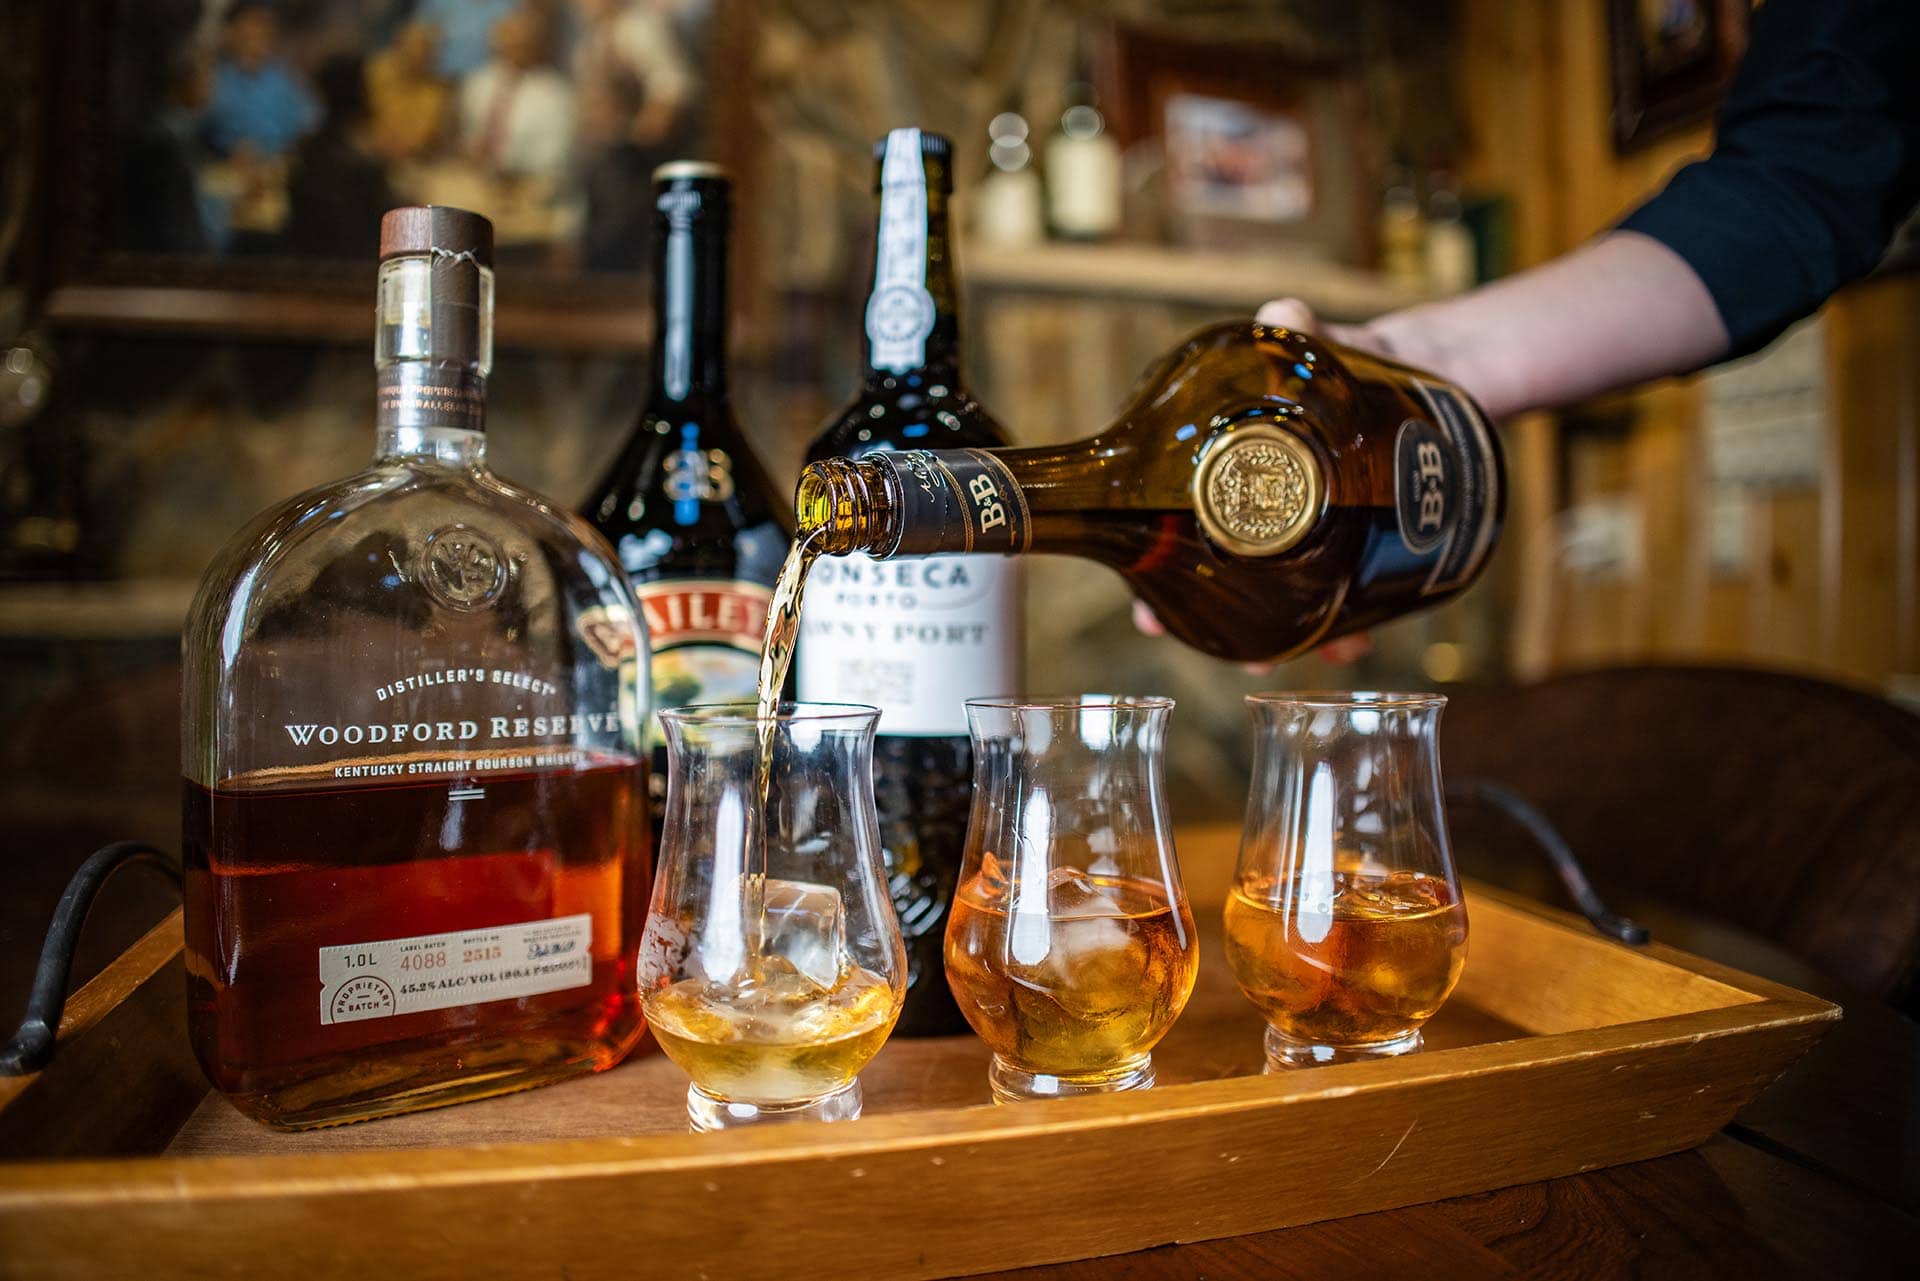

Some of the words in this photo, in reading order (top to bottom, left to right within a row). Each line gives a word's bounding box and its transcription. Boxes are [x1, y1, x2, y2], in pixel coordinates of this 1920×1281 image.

[1417, 442, 1444, 532] B&B
[968, 474, 1006, 534] B&B
[811, 561, 970, 589] ONSECA
[376, 668, 485, 701] DISTILLER'S
[492, 670, 550, 696] SELECT
[284, 720, 479, 746] WOODFORD
[490, 712, 619, 739] RESERVE
[335, 764, 403, 778] KENTUCKY
[408, 760, 472, 774] STRAIGHT
[475, 755, 532, 771] BOURBON
[400, 951, 447, 972] 4088
[336, 982, 391, 1014] PROPRIETARY
[400, 981, 436, 994] 45.2%
[348, 1001, 380, 1012] BATCH
